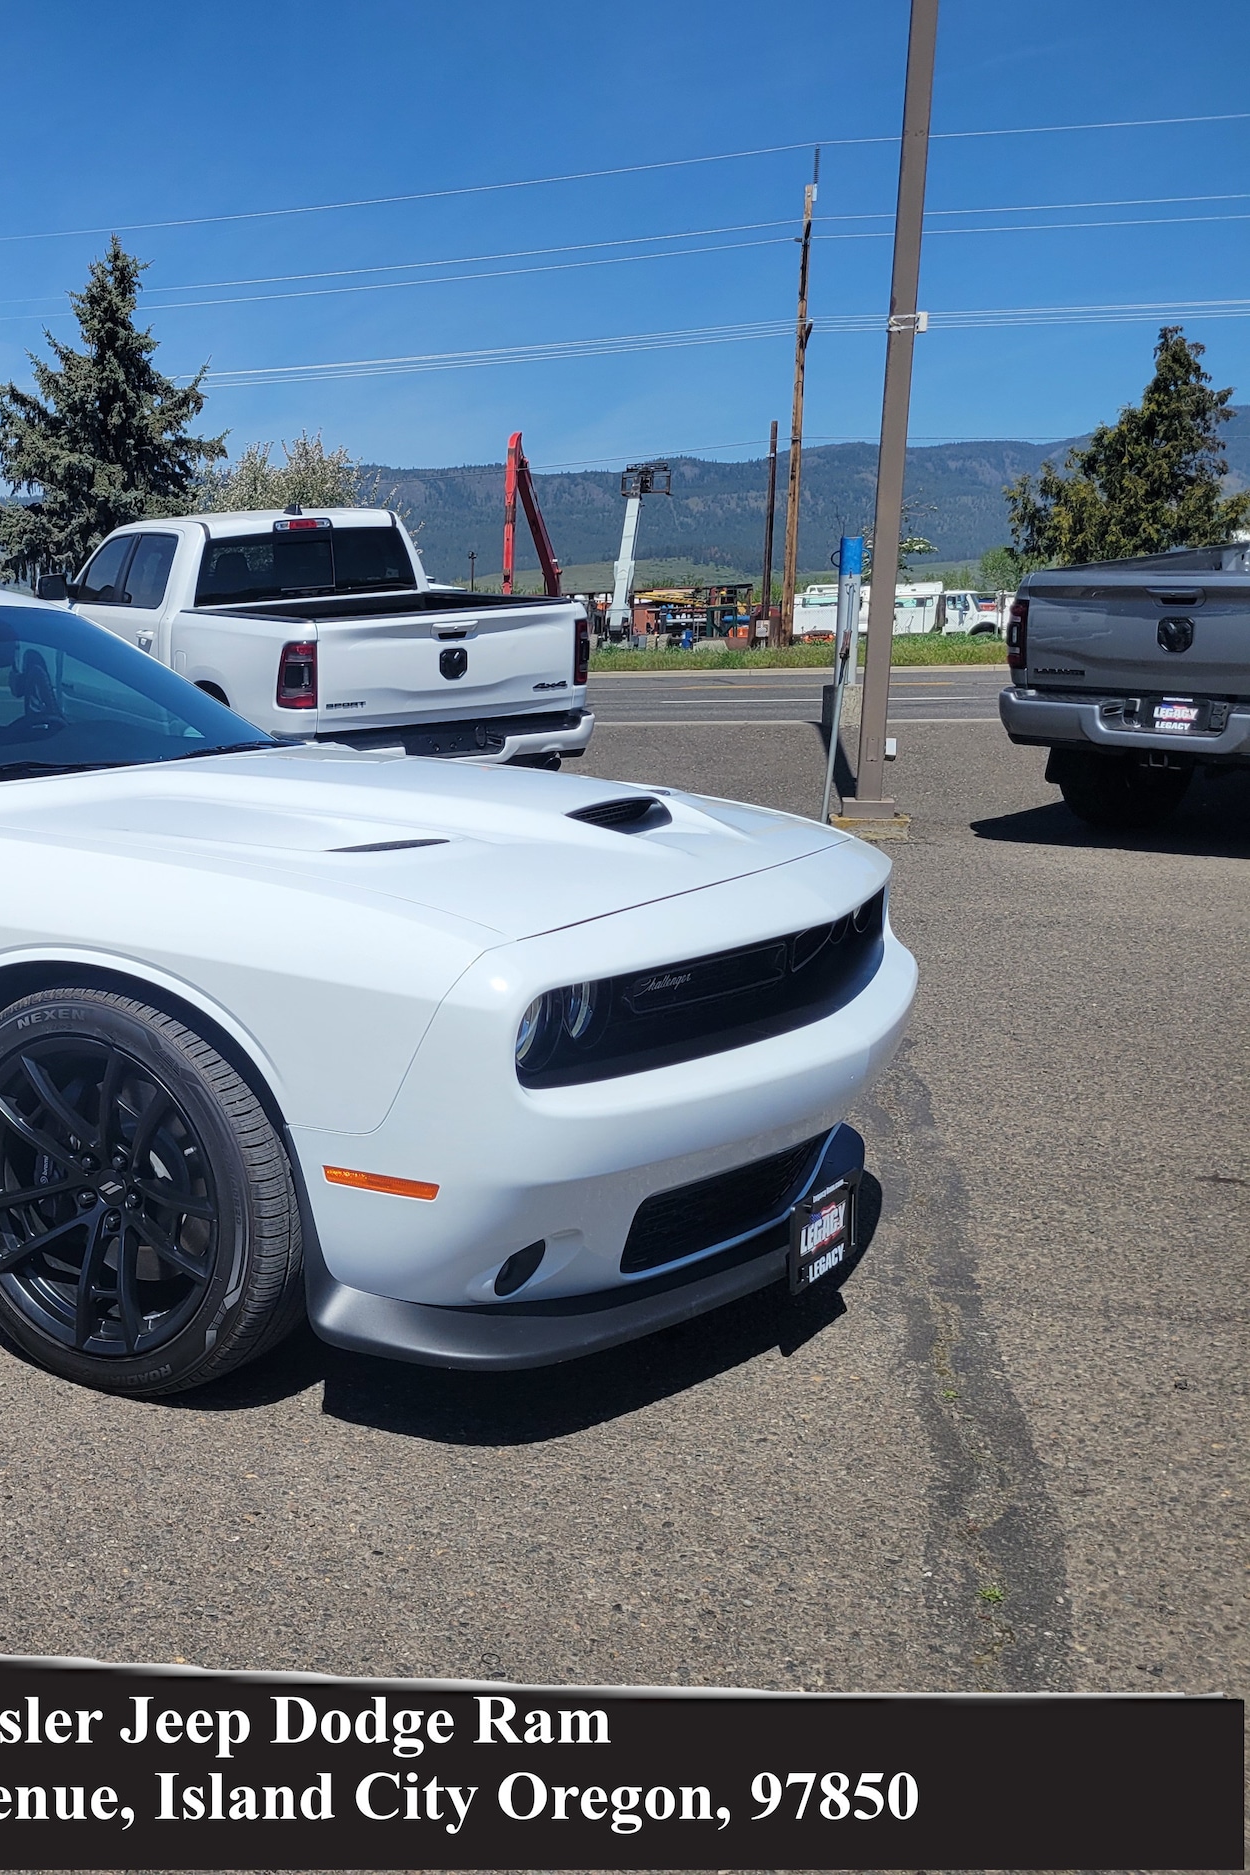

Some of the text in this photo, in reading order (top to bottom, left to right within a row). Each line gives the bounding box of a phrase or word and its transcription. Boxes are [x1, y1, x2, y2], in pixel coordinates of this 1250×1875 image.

[532, 680, 568, 692] 4x4
[325, 700, 366, 710] SPORT
[1153, 706, 1199, 720] LEGACY
[1155, 720, 1190, 730] LEGACY
[633, 973, 692, 998] Challenger
[16, 1008, 85, 1030] NEXEN
[800, 1202, 847, 1255] LEGACY
[809, 1242, 845, 1283] LEGACY
